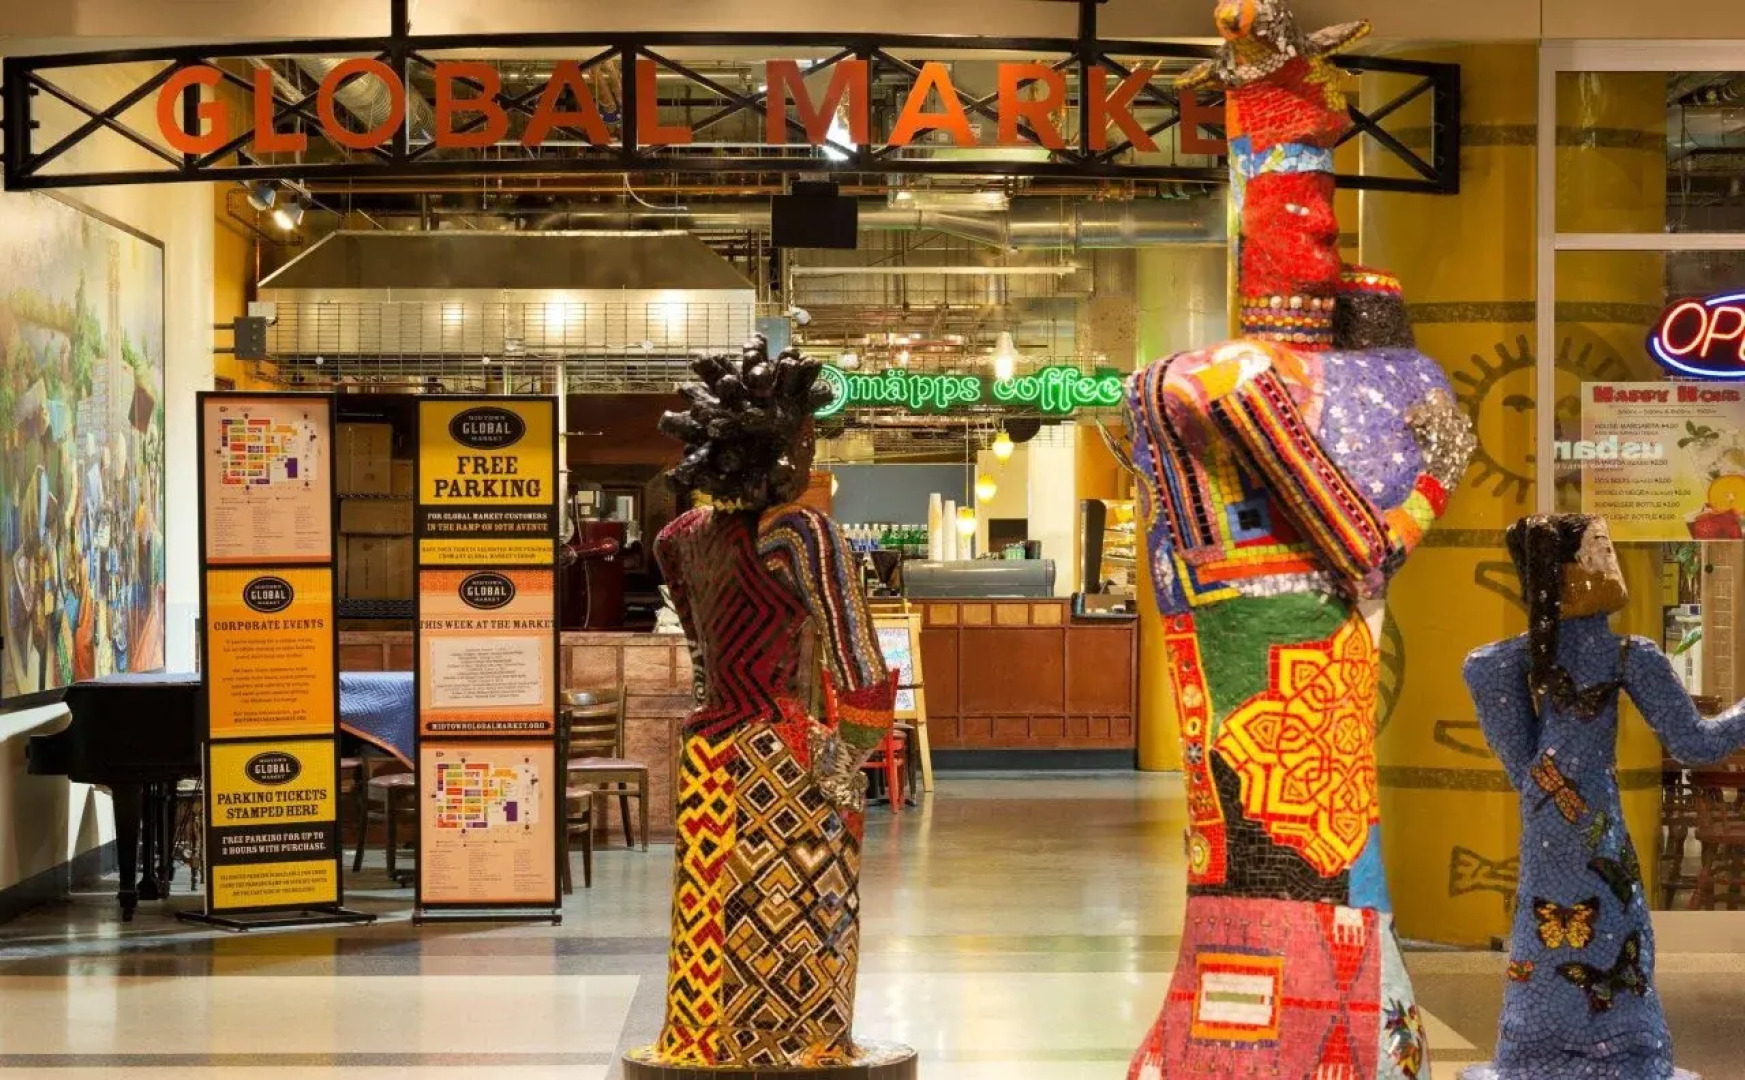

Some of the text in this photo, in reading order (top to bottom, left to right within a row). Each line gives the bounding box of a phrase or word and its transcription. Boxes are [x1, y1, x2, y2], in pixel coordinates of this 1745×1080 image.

[157, 58, 1226, 155] GLOBAL MARKE
[1661, 302, 1745, 362] OP
[849, 366, 1123, 411] mäpps coffee
[462, 422, 511, 434] GLOBAL
[457, 456, 518, 475] FREE
[434, 479, 541, 498] PARKING
[427, 523, 436, 531] IN
[437, 523, 455, 531] THE
[455, 523, 481, 532] RAMP
[482, 523, 493, 531] ON
[516, 523, 548, 531] AVENUE
[251, 590, 286, 600] GLOBAL
[467, 586, 506, 596] GLOBAL
[213, 618, 324, 632] CORPORATE EVENTS
[420, 619, 554, 629] THIS WEEK AT THE MARKET
[254, 763, 291, 774] GLOBAL
[217, 789, 327, 805] PARKING TICKETS
[226, 804, 319, 819] STAMPED HERE
[222, 831, 324, 845] FREE PARKING FOR UP TO
[229, 846, 257, 855] HOURS
[258, 845, 280, 854] WITH
